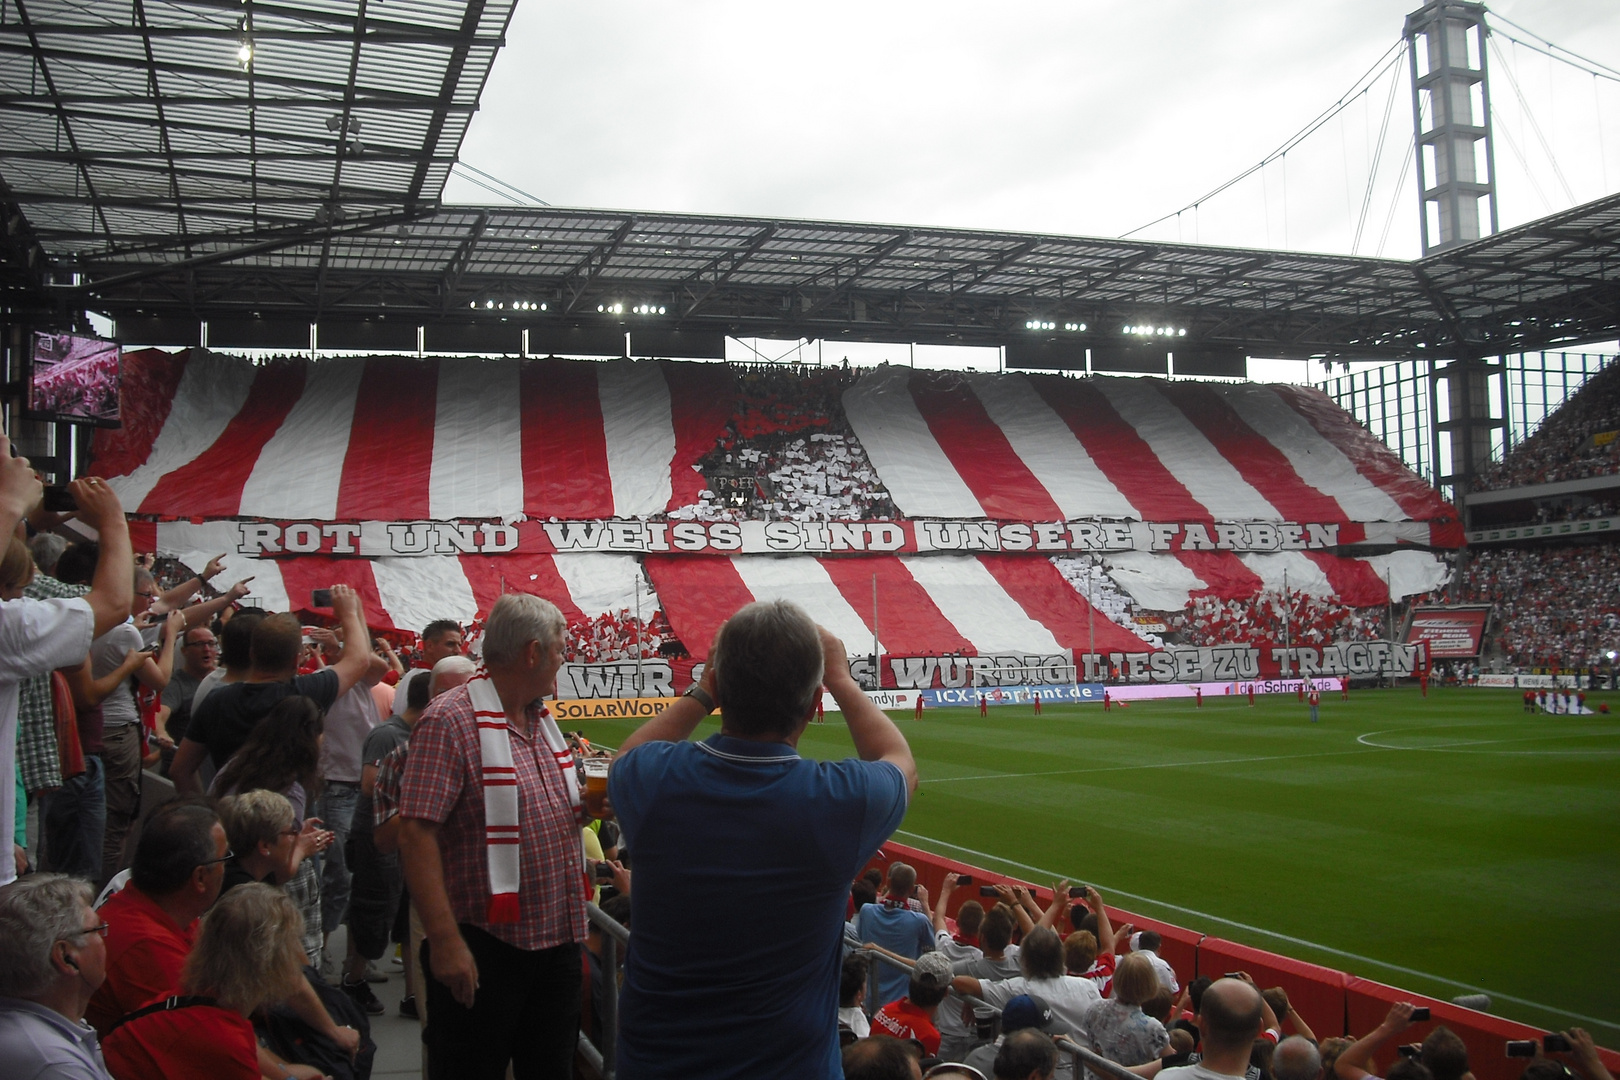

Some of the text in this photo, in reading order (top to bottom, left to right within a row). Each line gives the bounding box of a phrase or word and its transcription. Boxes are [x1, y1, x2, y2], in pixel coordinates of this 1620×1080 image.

[238, 521, 1338, 554] ROT UND WEISS SIND UNSERE FARBEN
[567, 663, 676, 699] WIR
[1081, 650, 1202, 683] DIESE
[1211, 649, 1260, 680] ZU
[1272, 643, 1427, 677] TRAGEN!
[555, 700, 671, 718] SOLARWOR
